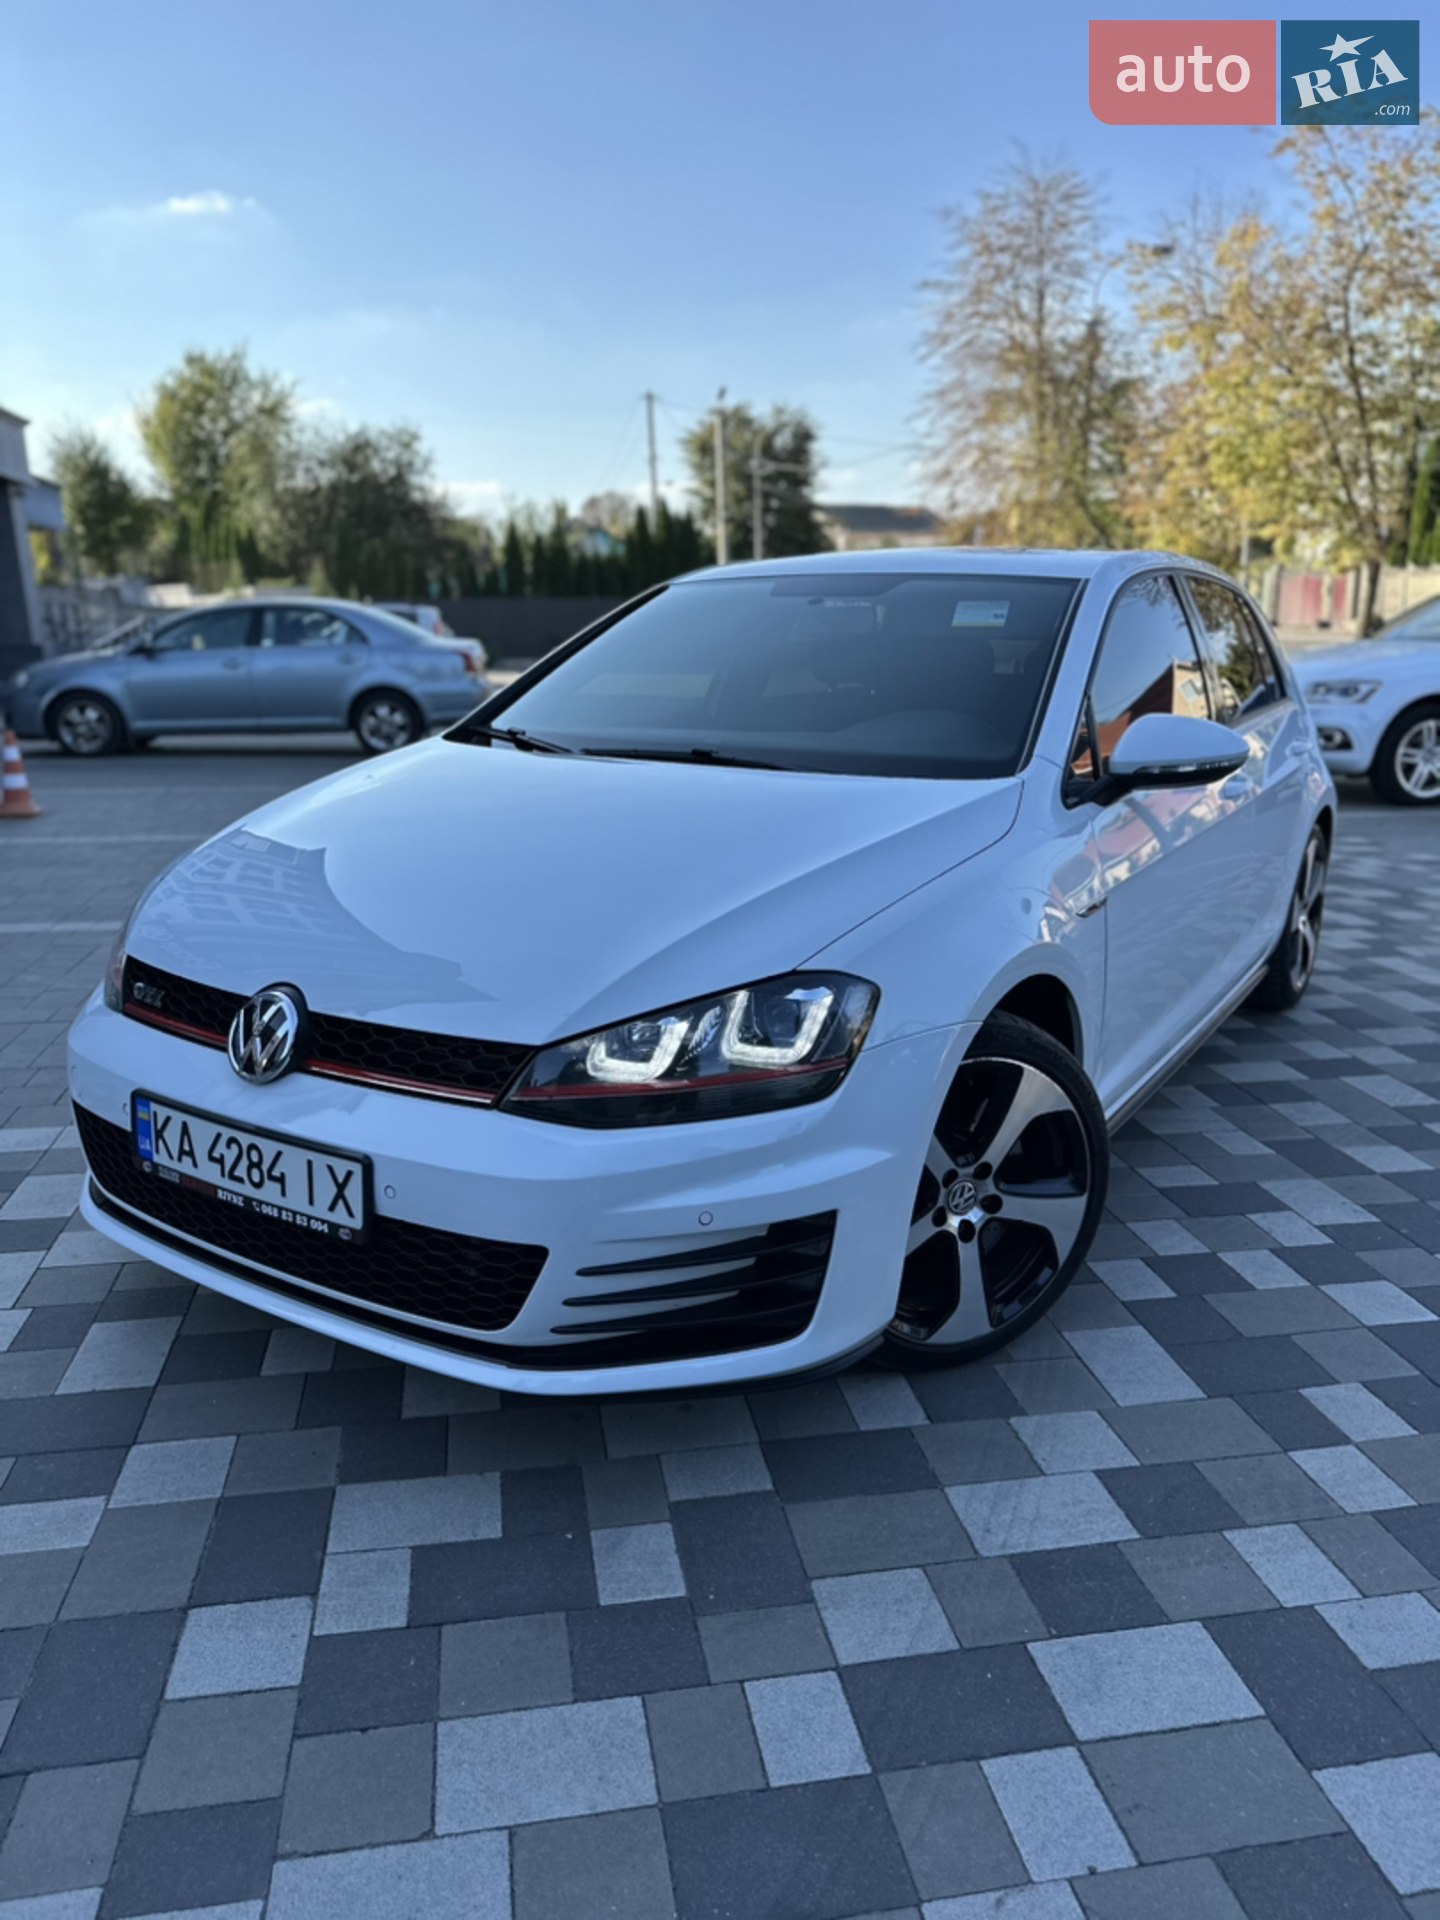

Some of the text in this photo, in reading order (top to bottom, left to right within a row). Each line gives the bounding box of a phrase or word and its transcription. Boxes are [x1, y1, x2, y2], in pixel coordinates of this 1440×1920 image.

[153, 1110, 355, 1218] KA 4284 IX
